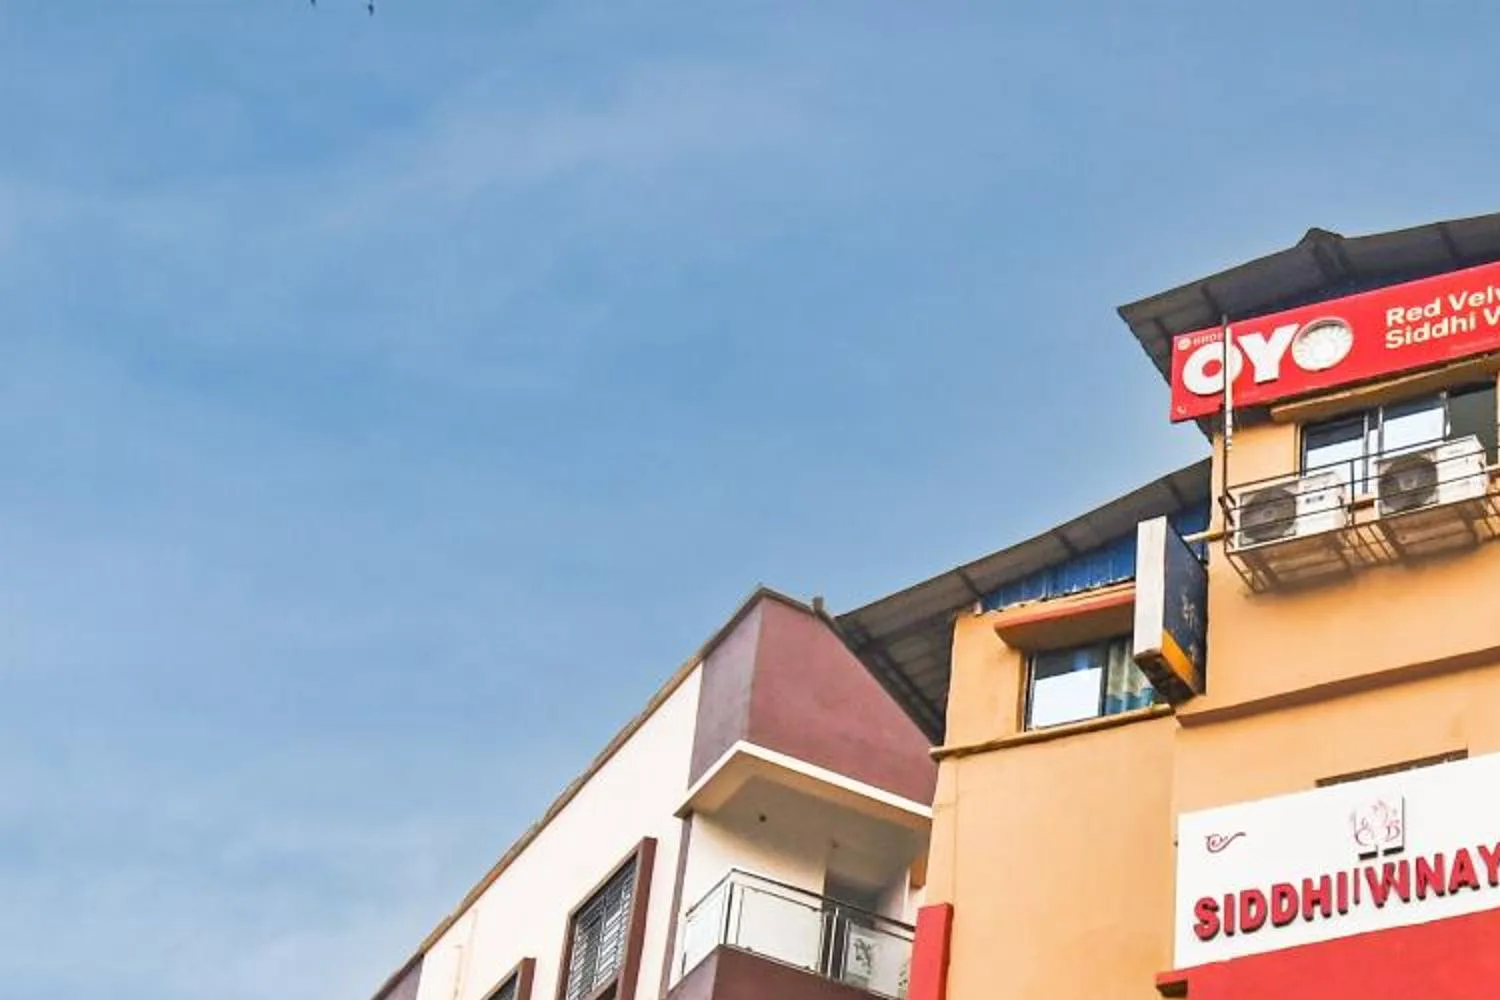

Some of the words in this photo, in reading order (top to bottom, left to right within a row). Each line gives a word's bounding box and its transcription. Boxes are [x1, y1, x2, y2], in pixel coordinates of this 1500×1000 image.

[1385, 311, 1477, 349] Siddhi
[1386, 298, 1442, 328] Red
[1182, 316, 1355, 396] OYO
